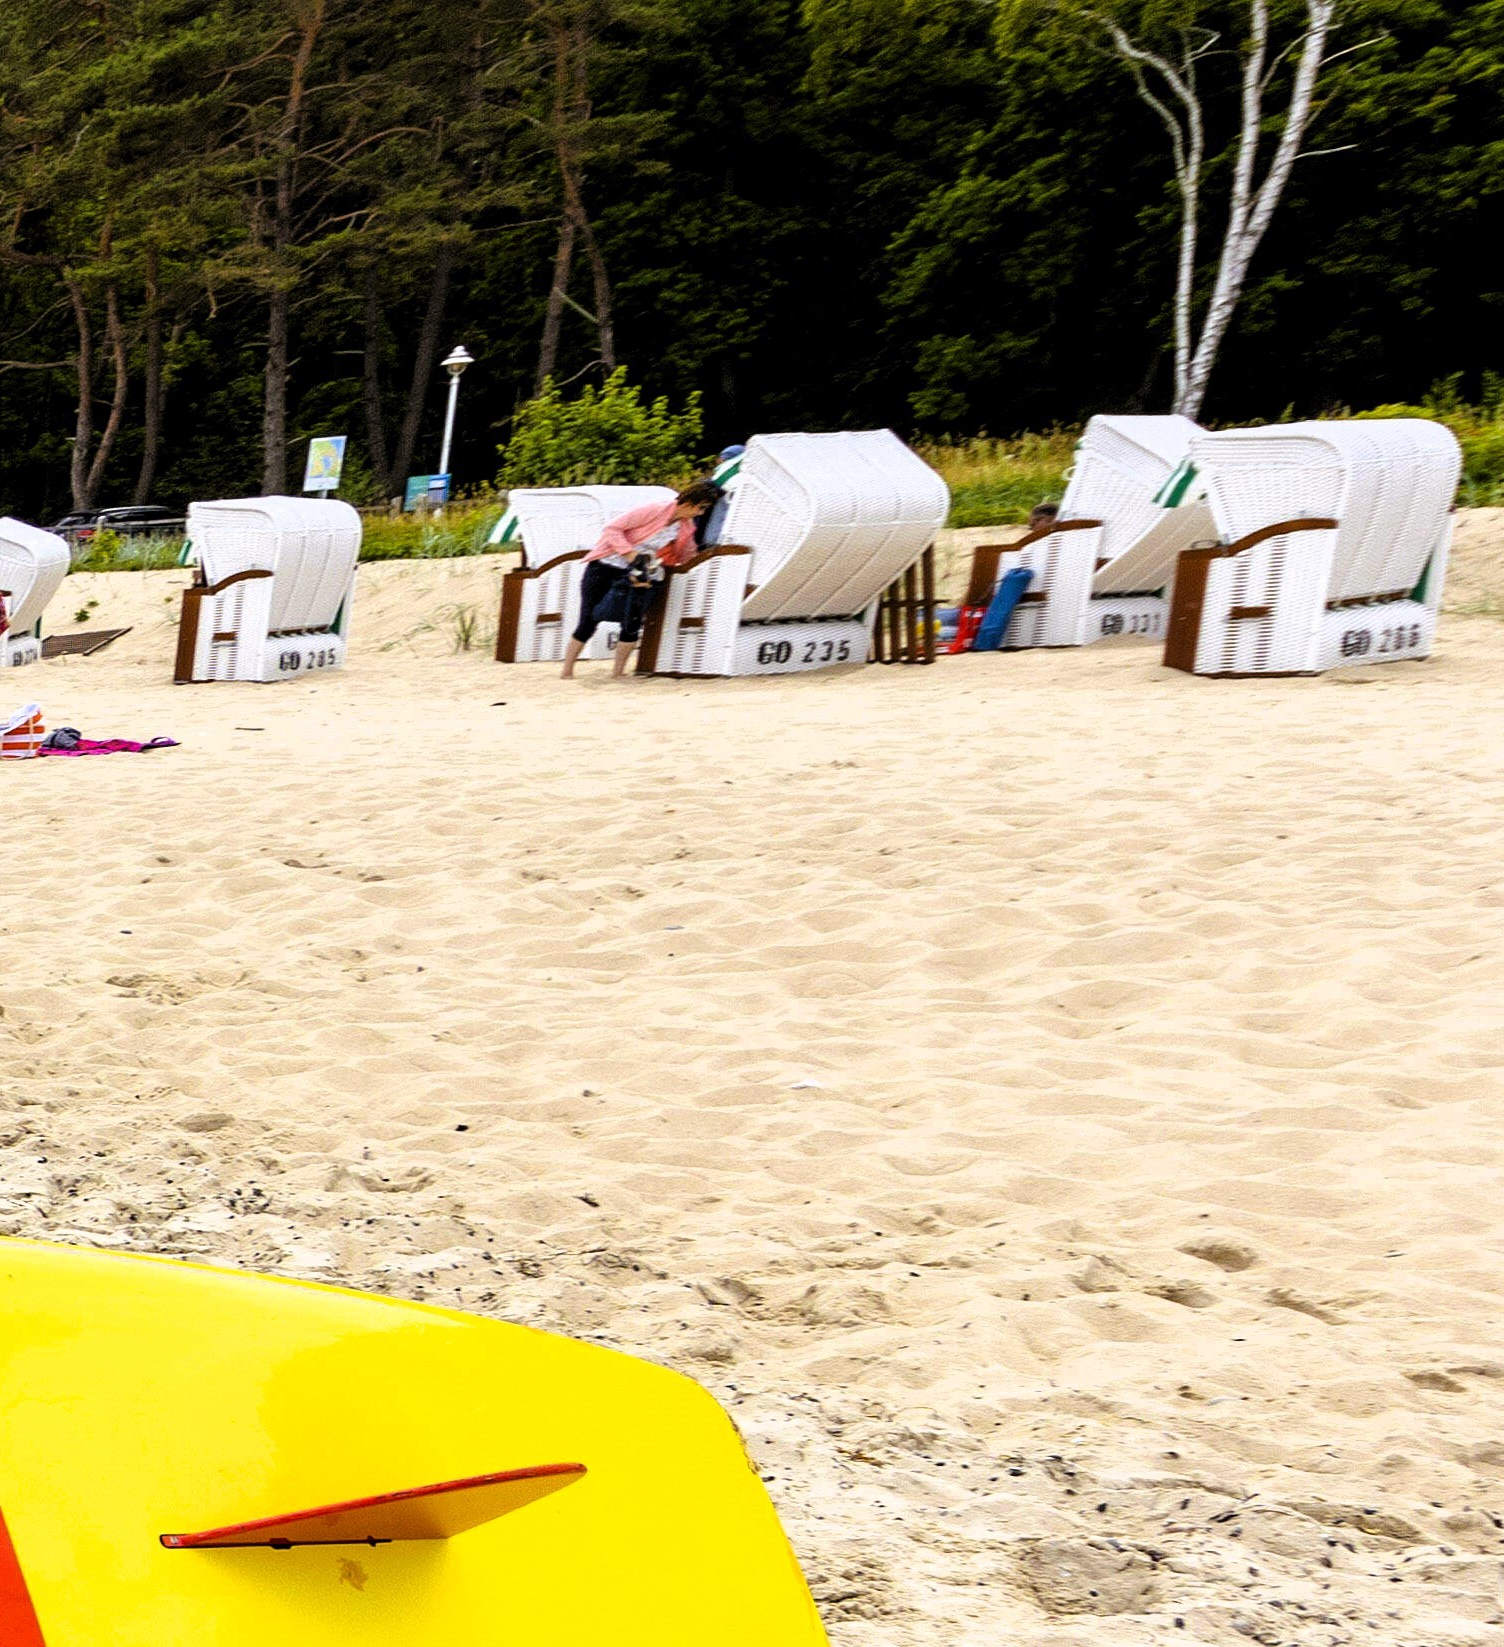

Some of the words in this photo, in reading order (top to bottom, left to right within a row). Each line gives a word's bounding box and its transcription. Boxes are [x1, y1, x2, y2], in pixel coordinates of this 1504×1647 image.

[756, 640, 792, 664] GO
[801, 639, 851, 662] 235
[1341, 629, 1371, 657] GO
[278, 652, 301, 671] GO
[306, 648, 336, 668] 285
